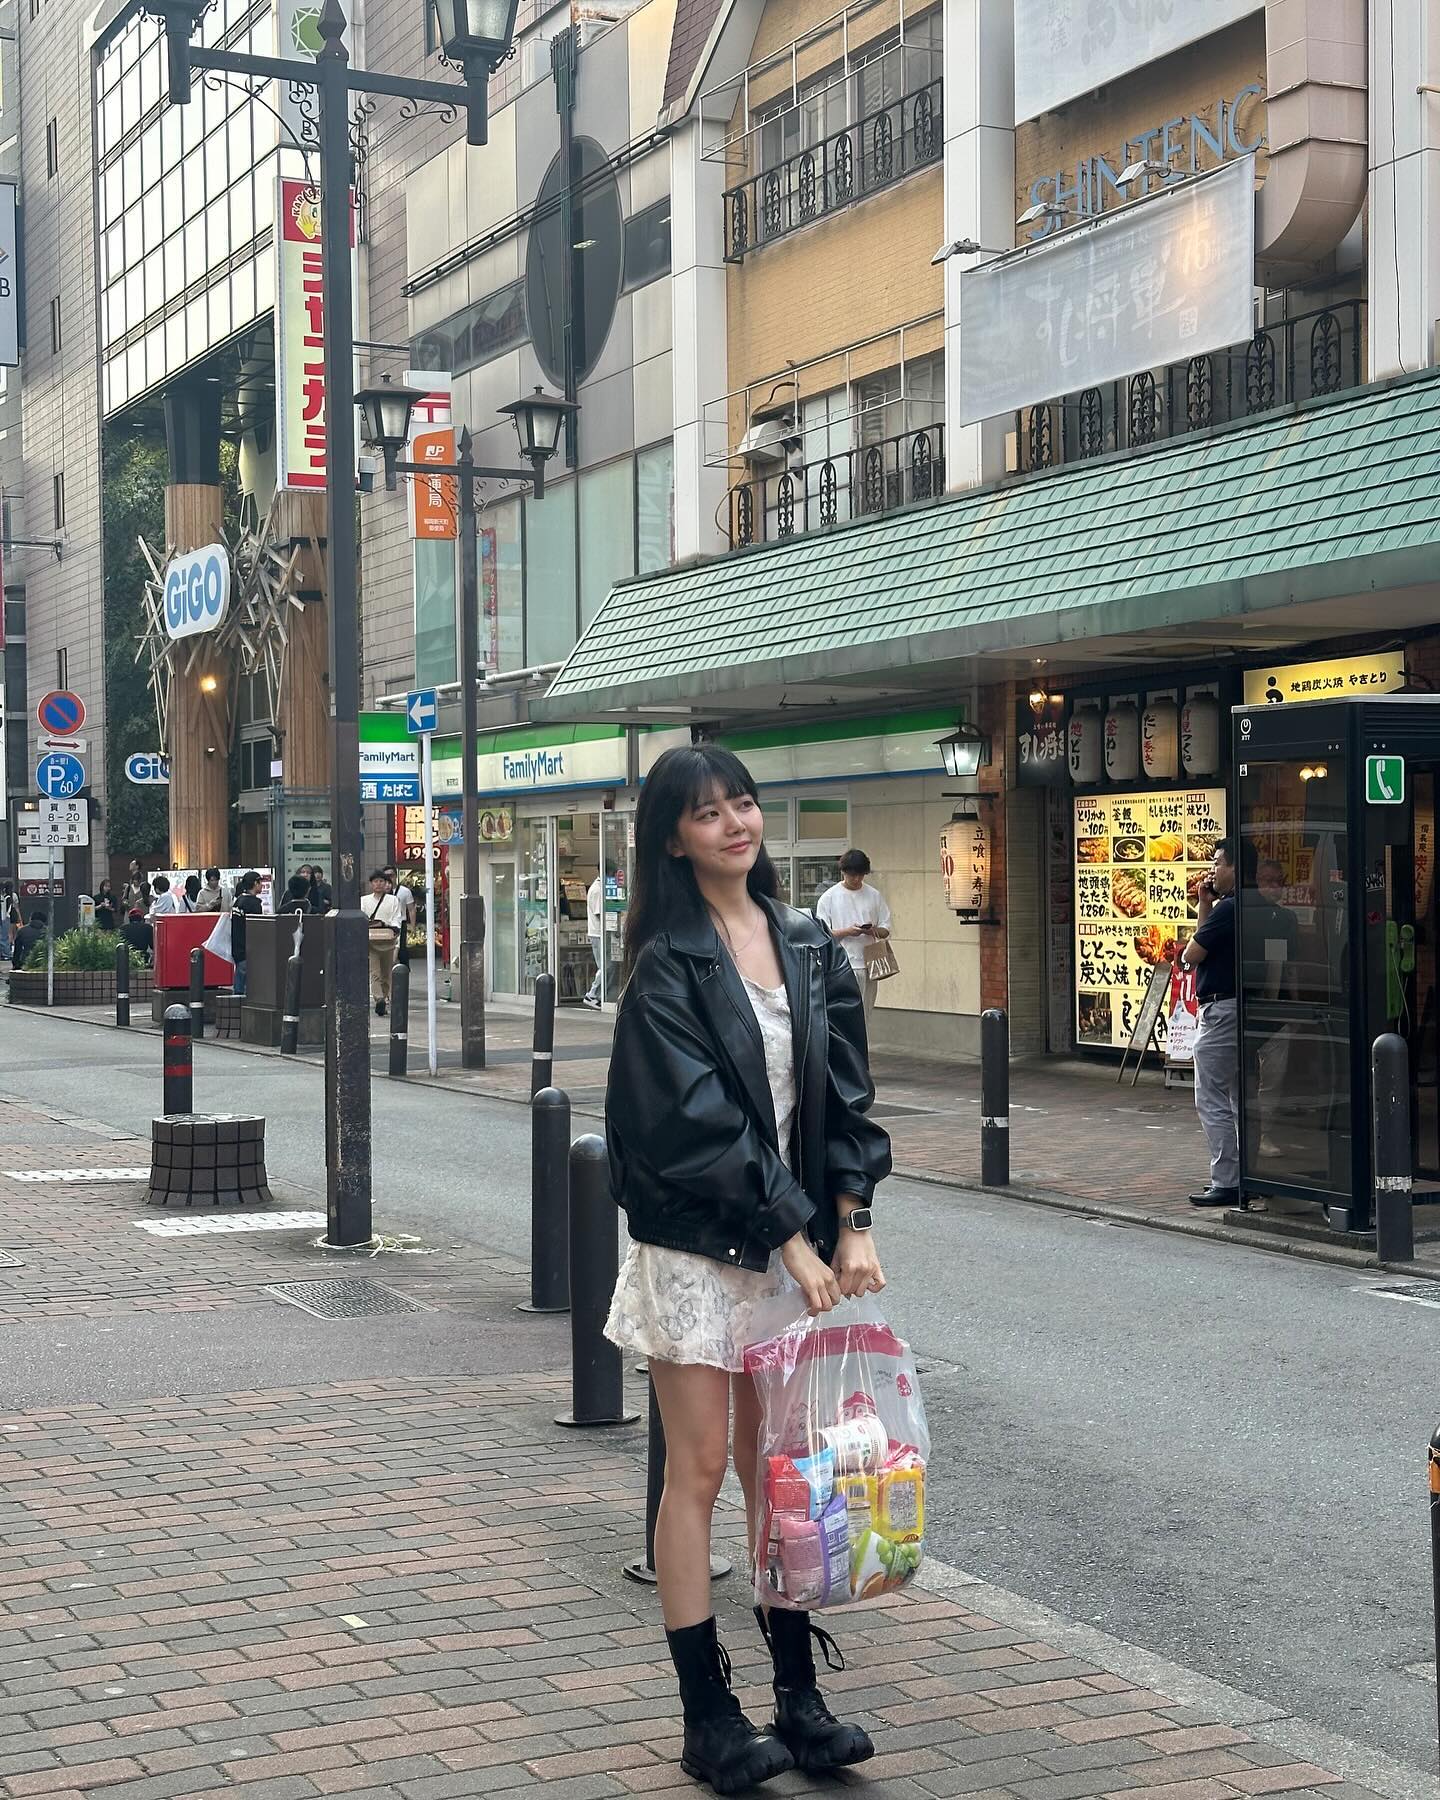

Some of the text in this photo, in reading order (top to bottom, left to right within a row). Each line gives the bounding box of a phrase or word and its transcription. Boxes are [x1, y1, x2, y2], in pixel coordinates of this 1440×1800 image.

[428, 473, 442, 508] 便局
[167, 555, 222, 629] GiGO
[1349, 671, 1388, 687] やきとり
[1071, 720, 1082, 771] 地どり
[1105, 718, 1118, 767] 釜めし
[359, 752, 415, 764] FamilyMart
[503, 751, 564, 784] FamilyMart
[47, 765, 66, 794] P
[73, 774, 79, 782] 分
[60, 781, 74, 794] 60
[361, 782, 414, 799] 酒 たばこ
[1077, 809, 1106, 822] とりかわ
[1112, 807, 1132, 821] 釜飯
[1186, 803, 1210, 816] 焼とり
[1160, 819, 1183, 833] 630円
[970, 827, 986, 908] 立喰い寿司
[1079, 890, 1110, 903] たたき
[1149, 885, 1185, 903] 月見つくね
[1080, 940, 1128, 960] じとっこ
[1080, 960, 1130, 986] 炭火焼
